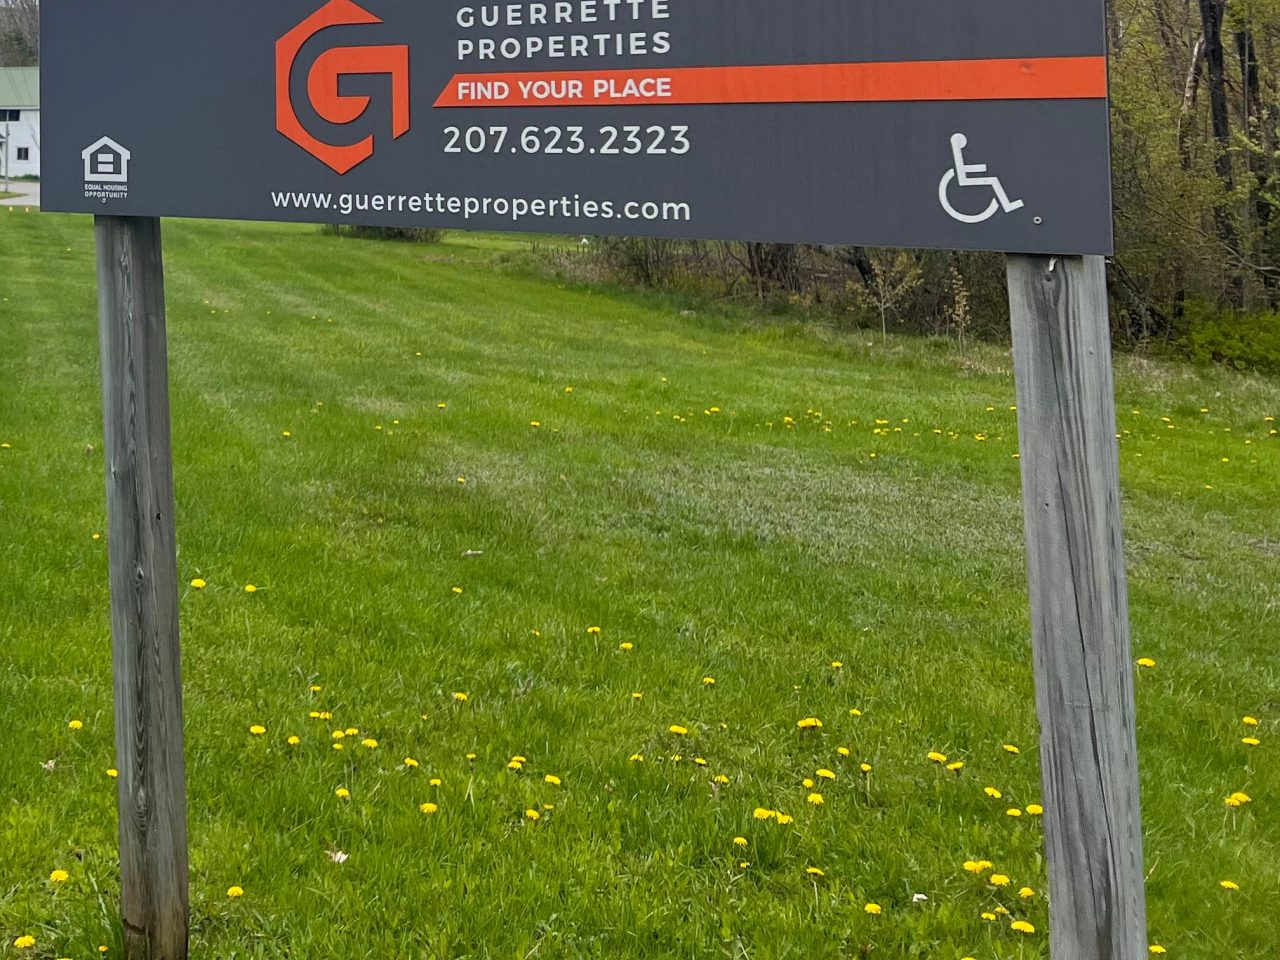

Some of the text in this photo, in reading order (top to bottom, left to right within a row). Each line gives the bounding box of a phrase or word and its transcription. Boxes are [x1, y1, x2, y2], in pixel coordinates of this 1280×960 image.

[457, 31, 671, 61] PROPERTIES
[457, 77, 672, 100] FIND YOUR PLACE
[443, 125, 691, 155] 207.623.2323
[84, 183, 128, 192] EQUAL HOUSING
[84, 191, 128, 199] OPPORTUNITY
[271, 190, 691, 221] www.guerretteproperties.com
